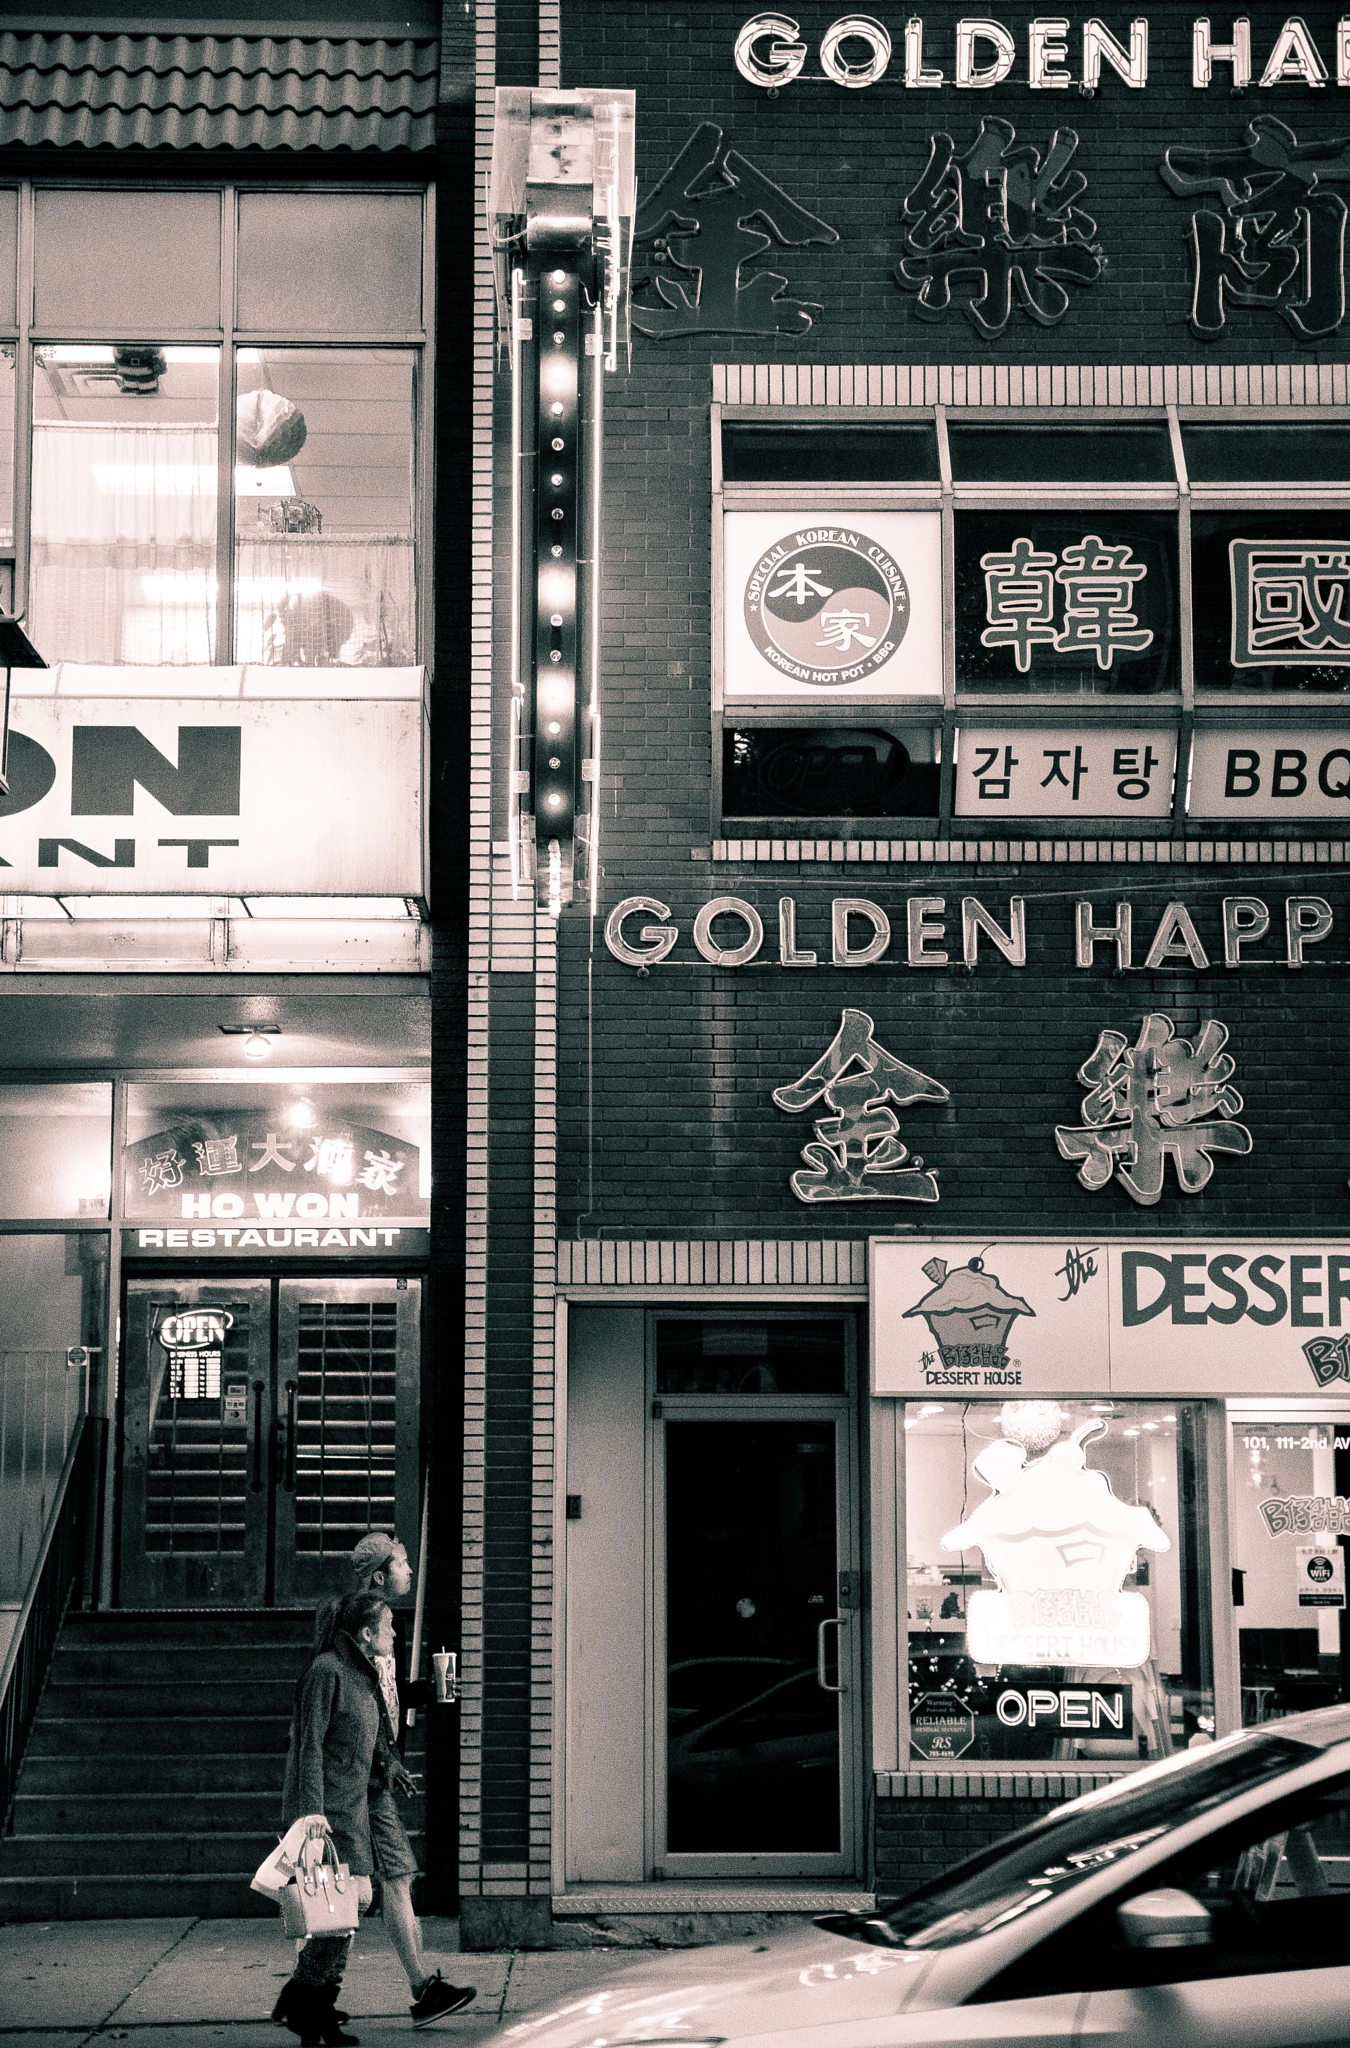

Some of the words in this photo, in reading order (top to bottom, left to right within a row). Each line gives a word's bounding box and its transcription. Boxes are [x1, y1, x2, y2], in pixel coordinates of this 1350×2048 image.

[734, 11, 1148, 89] GOLDEN
[1192, 15, 1350, 89] HA
[747, 545, 790, 601] SPECIAL
[795, 529, 860, 548] KOREAN
[867, 546, 907, 601] CUISINE
[764, 645, 811, 680] KOREAN
[812, 671, 839, 682] HOT
[841, 666, 866, 681] POT
[872, 640, 896, 665] BBQ
[0, 838, 240, 868] NT
[604, 896, 1027, 970] GOLDEN
[181, 1193, 245, 1219] HO
[254, 1193, 359, 1219] WON
[139, 1228, 400, 1248] RESTAURANT
[1054, 1247, 1100, 1302] the
[161, 1316, 224, 1343] OPEN
[926, 1371, 980, 1385] DESSERT
[983, 1371, 1022, 1385] HOUSE
[1242, 1436, 1270, 1451] 101,
[1275, 1436, 1328, 1450] 111-2nd
[1310, 1569, 1331, 1578] WiFi
[915, 1716, 967, 1725] RELIABLE
[996, 1690, 1124, 1729] OPEN
[932, 1736, 952, 1749] RS
